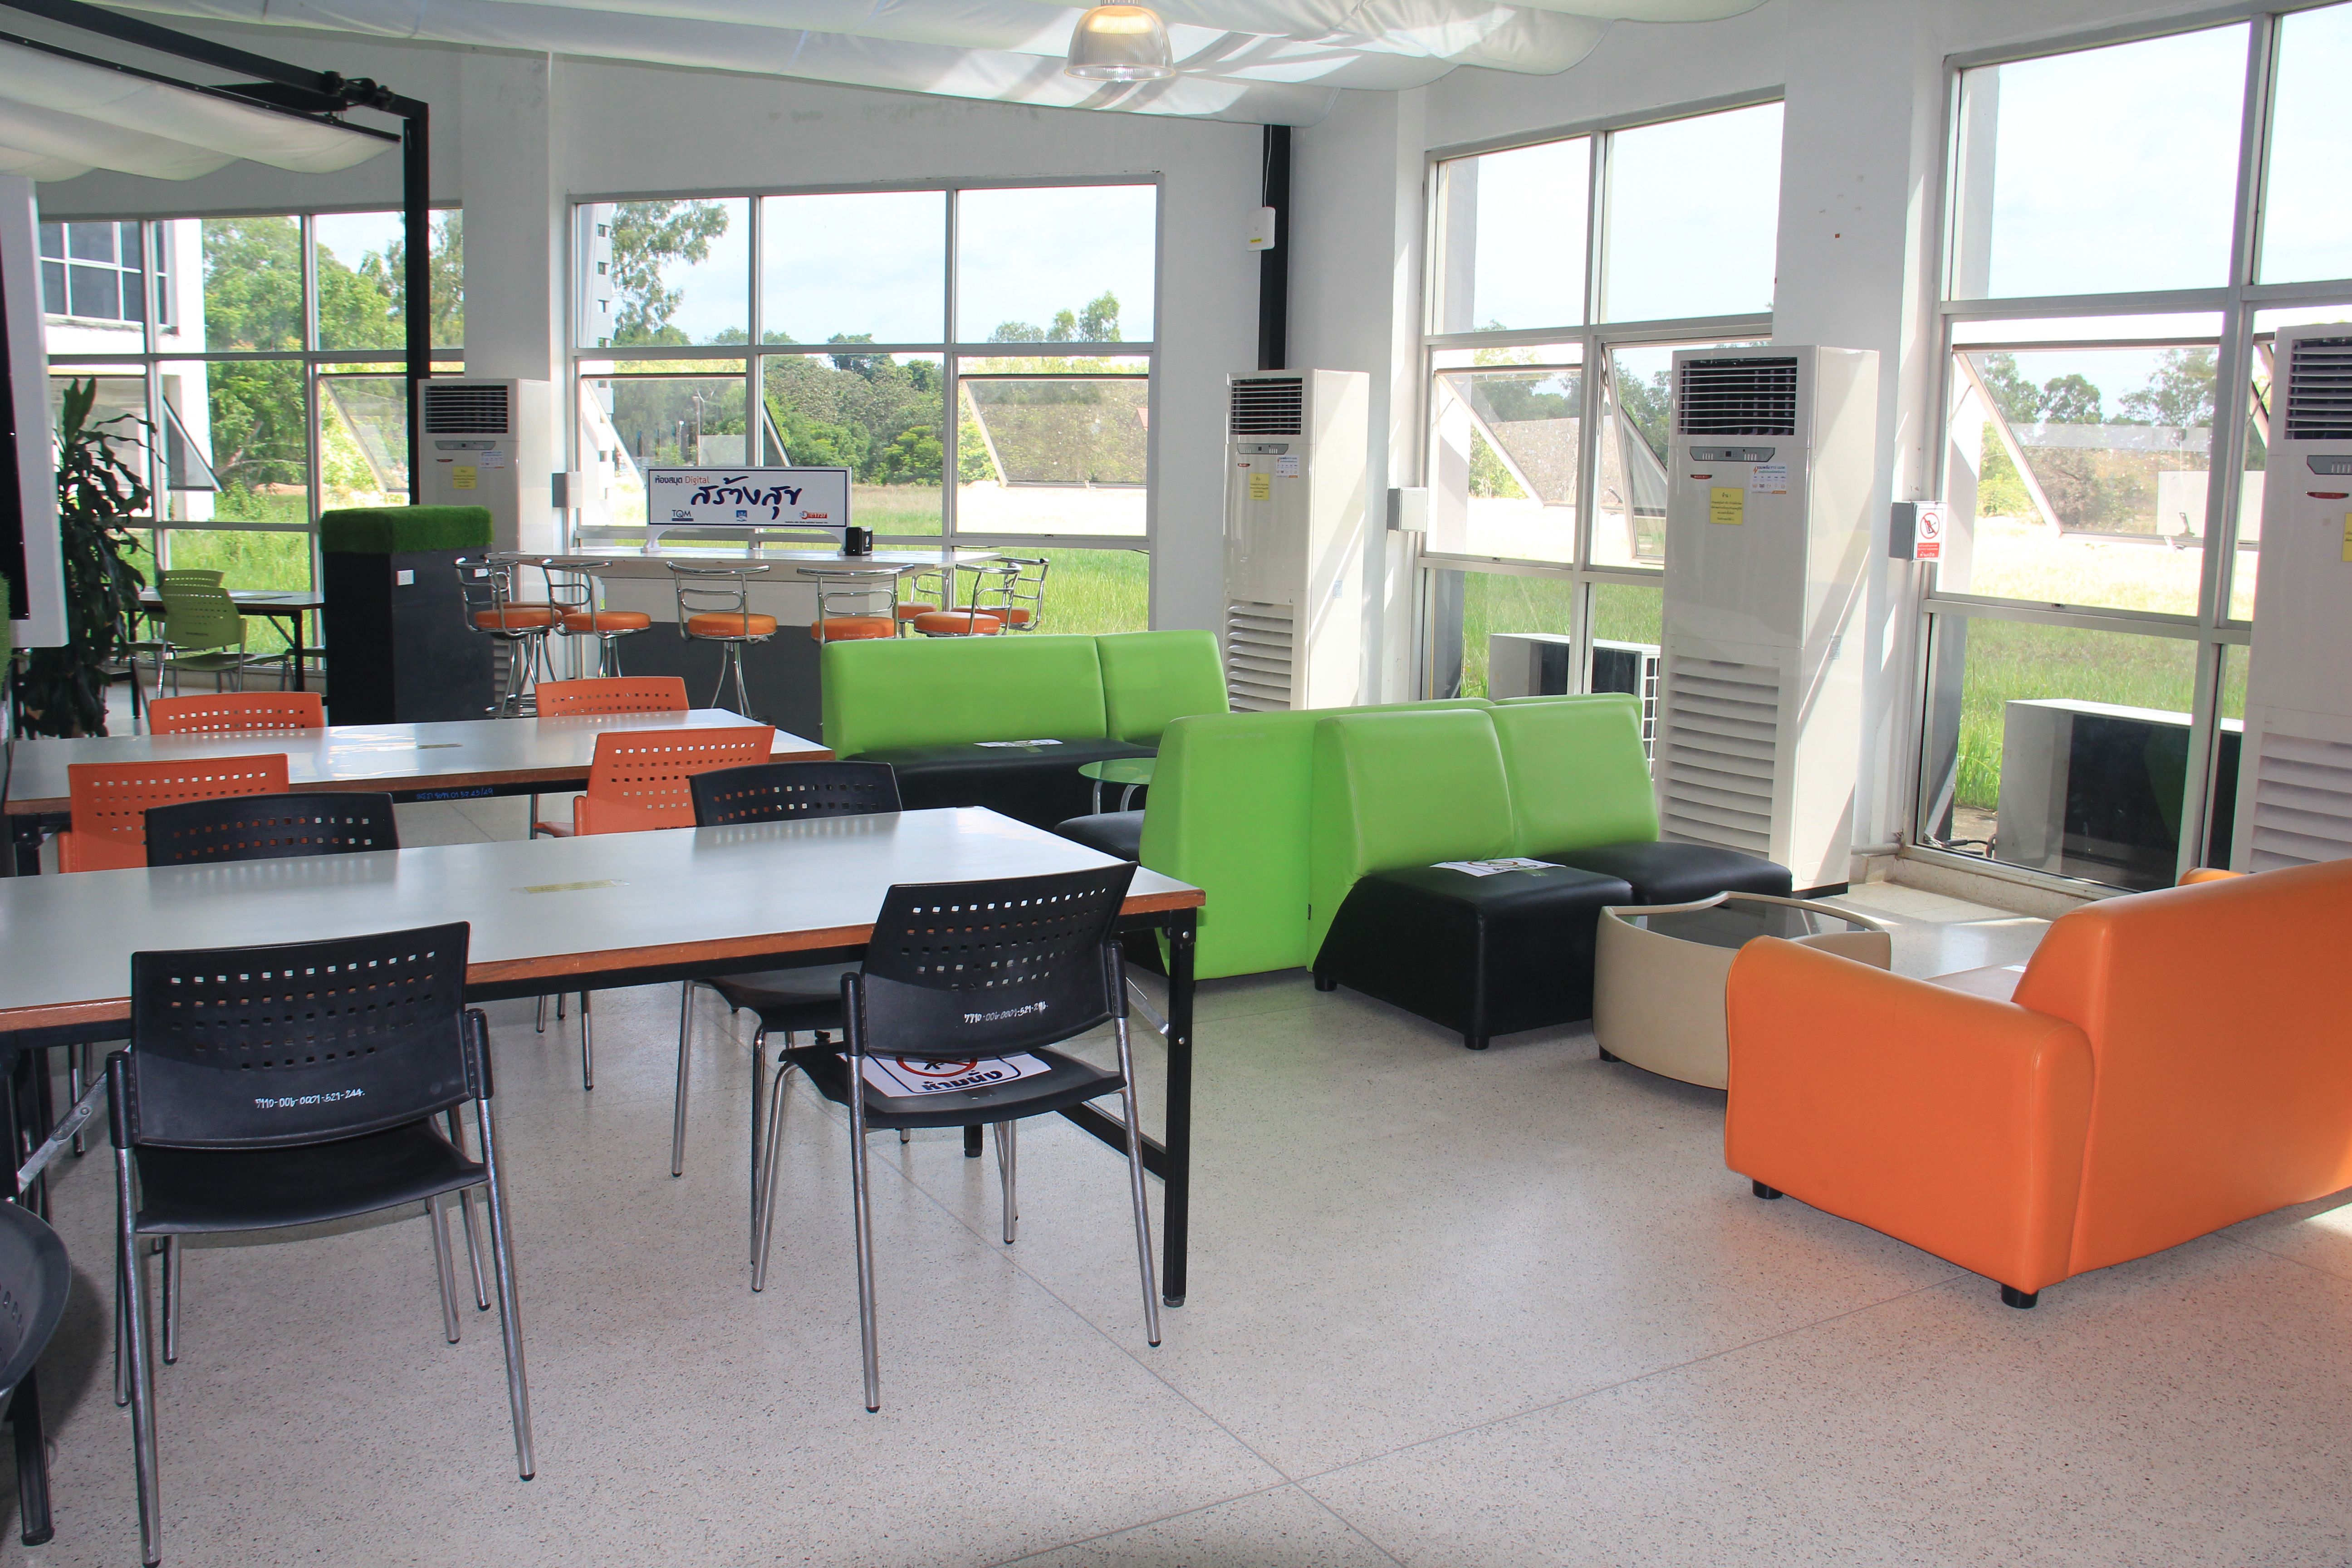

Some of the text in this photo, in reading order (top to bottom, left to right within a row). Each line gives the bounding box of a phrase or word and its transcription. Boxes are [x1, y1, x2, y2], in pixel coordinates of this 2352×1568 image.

[655, 475, 710, 485] ห้องสมุด Digital
[691, 475, 803, 520] สร้างสุข
[671, 510, 691, 518] TQM
[921, 1070, 1003, 1090] ห้ามนั่ง
